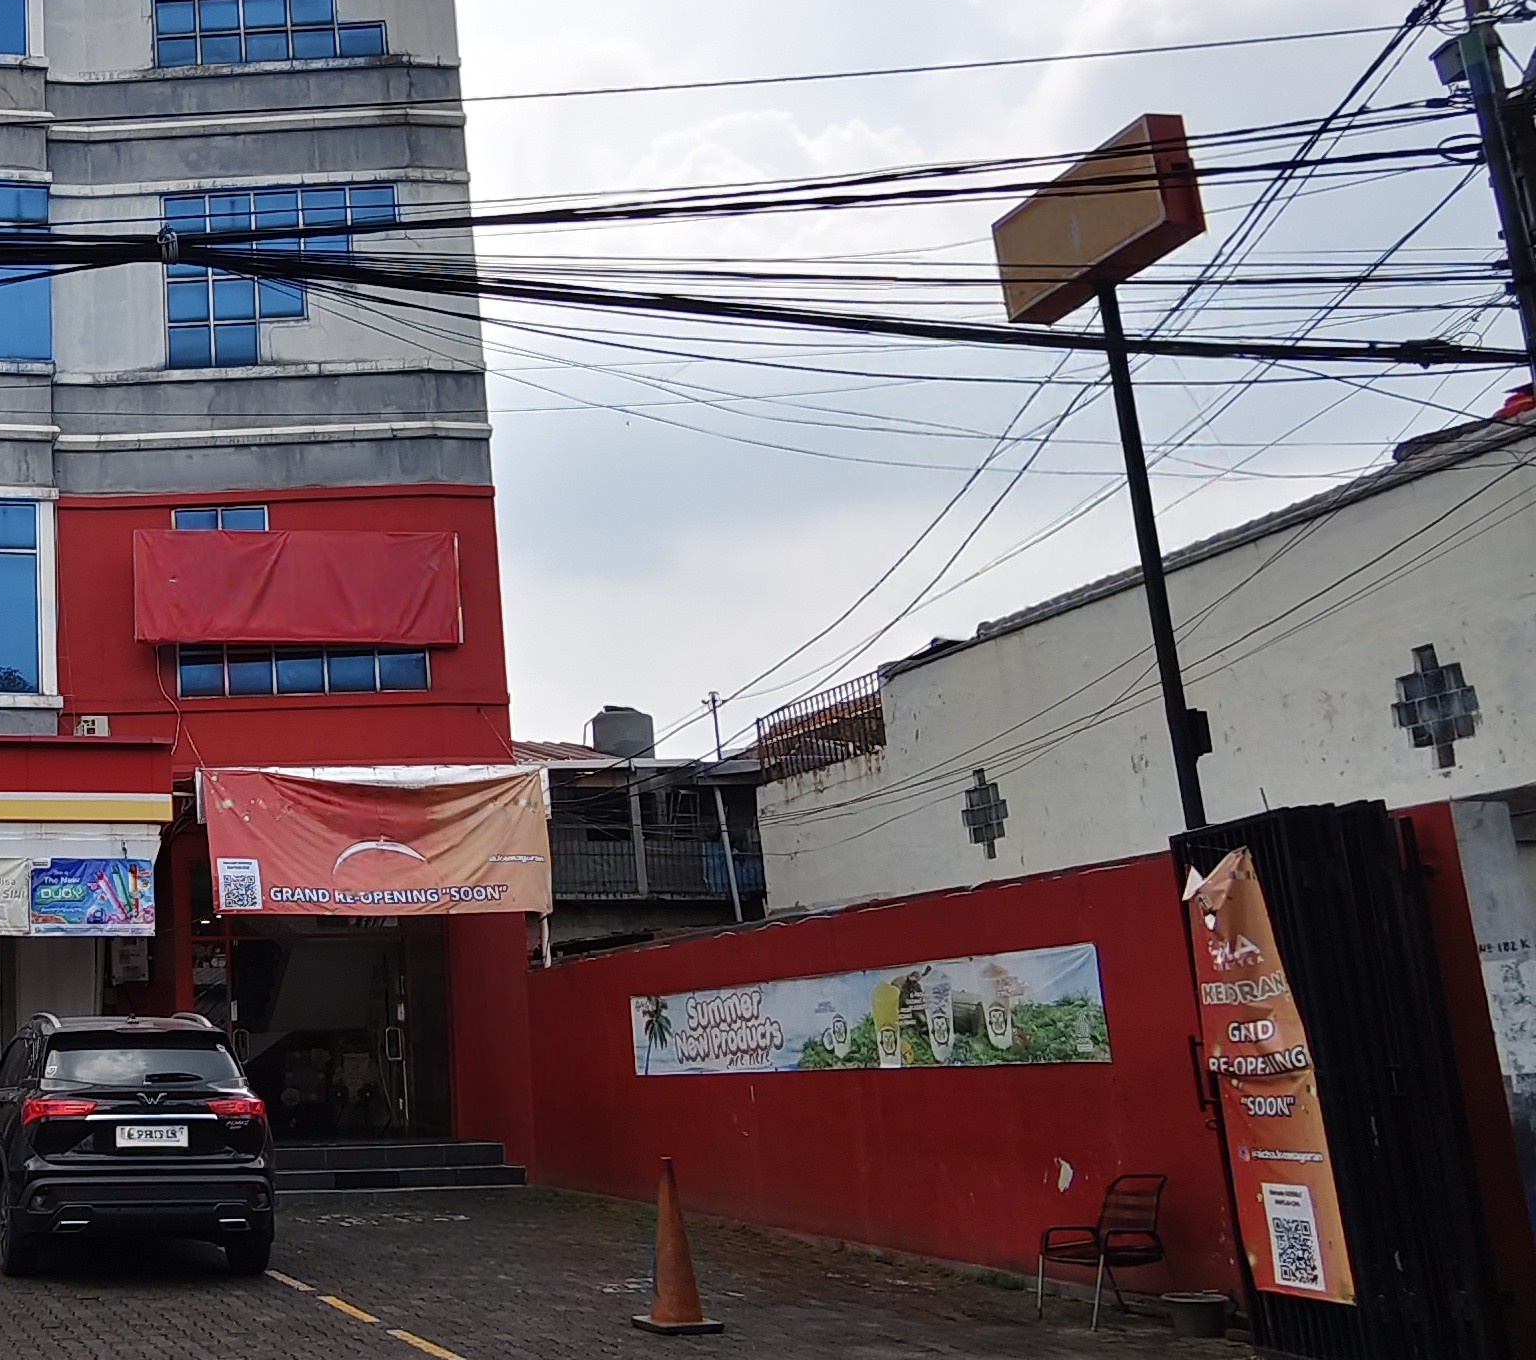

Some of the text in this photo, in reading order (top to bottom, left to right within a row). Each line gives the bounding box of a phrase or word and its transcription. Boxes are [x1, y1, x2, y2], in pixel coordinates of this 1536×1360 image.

[270, 885, 508, 903] GRAND RE-OPENING "SOON"
[686, 990, 762, 1032] Summer
[675, 1016, 784, 1064] New Products
[1241, 1096, 1295, 1116] "SOON"
